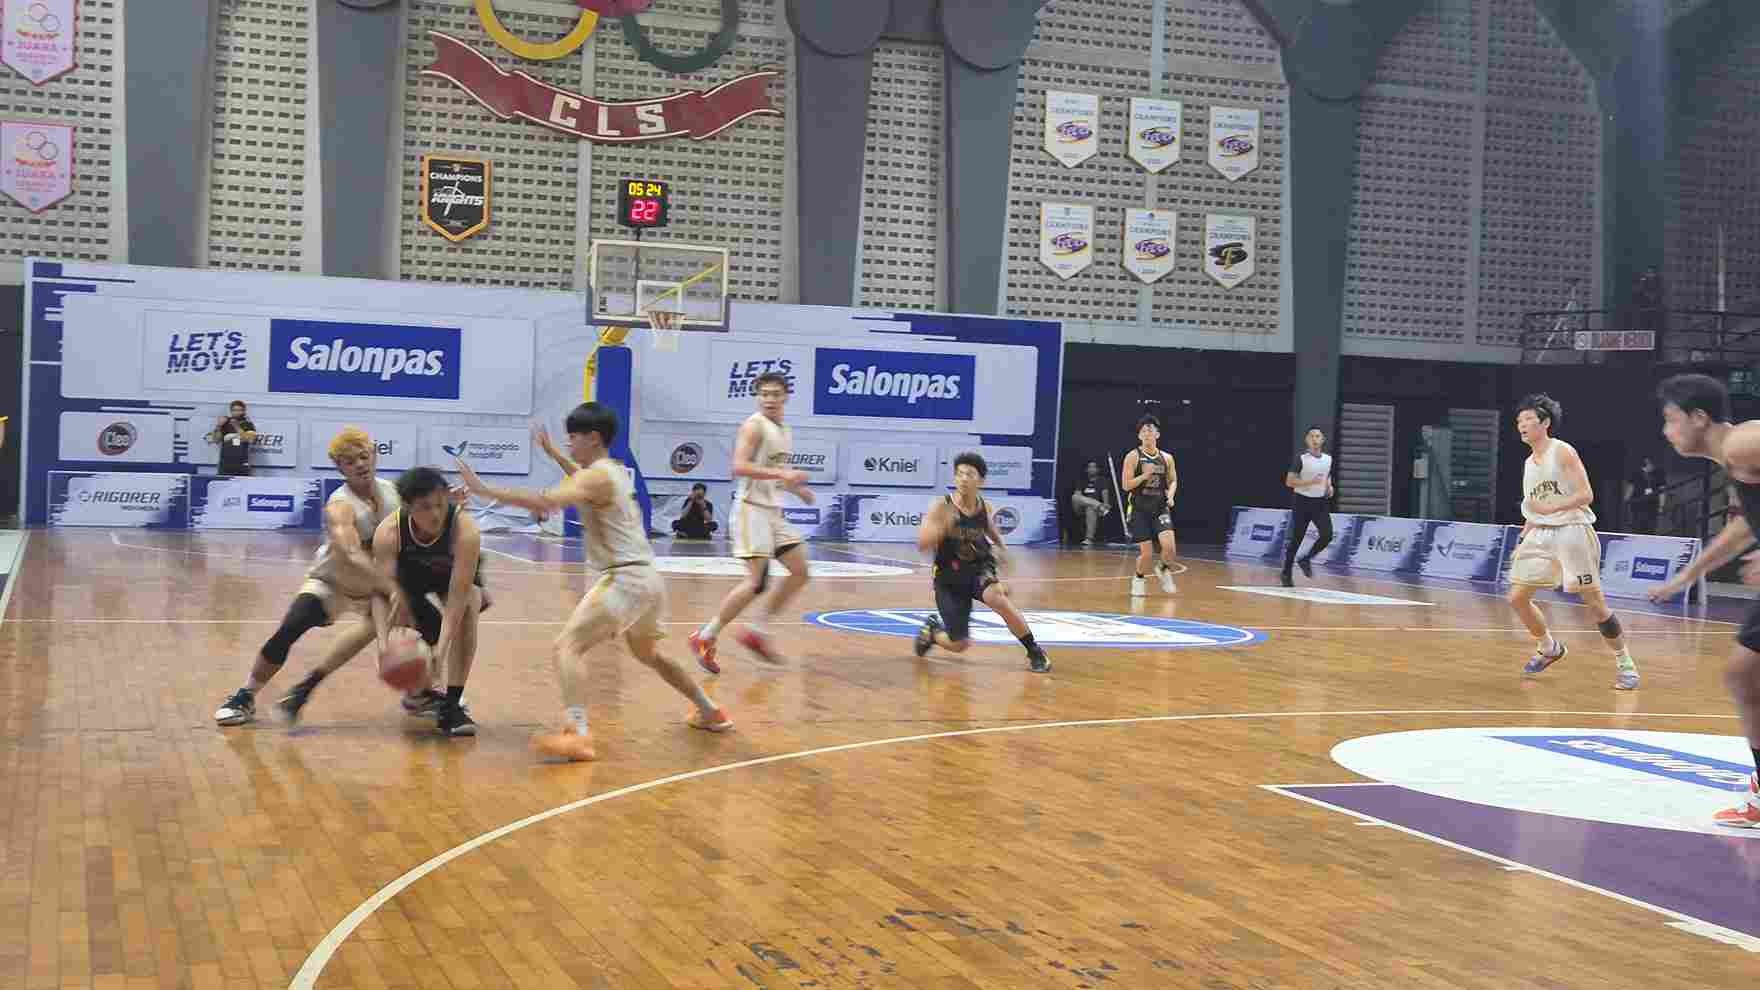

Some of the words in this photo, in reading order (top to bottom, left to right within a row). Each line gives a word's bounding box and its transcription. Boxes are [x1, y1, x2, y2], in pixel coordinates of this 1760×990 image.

[549, 94, 665, 136] CLS
[632, 200, 656, 220] 22
[169, 330, 242, 352] LET'S
[166, 349, 247, 374] MOVE
[286, 336, 444, 381] Salonpas
[828, 363, 960, 404] Salonpas
[878, 457, 918, 473] Kniel
[92, 491, 160, 504] RIGORER
[1577, 575, 1592, 585] 13
